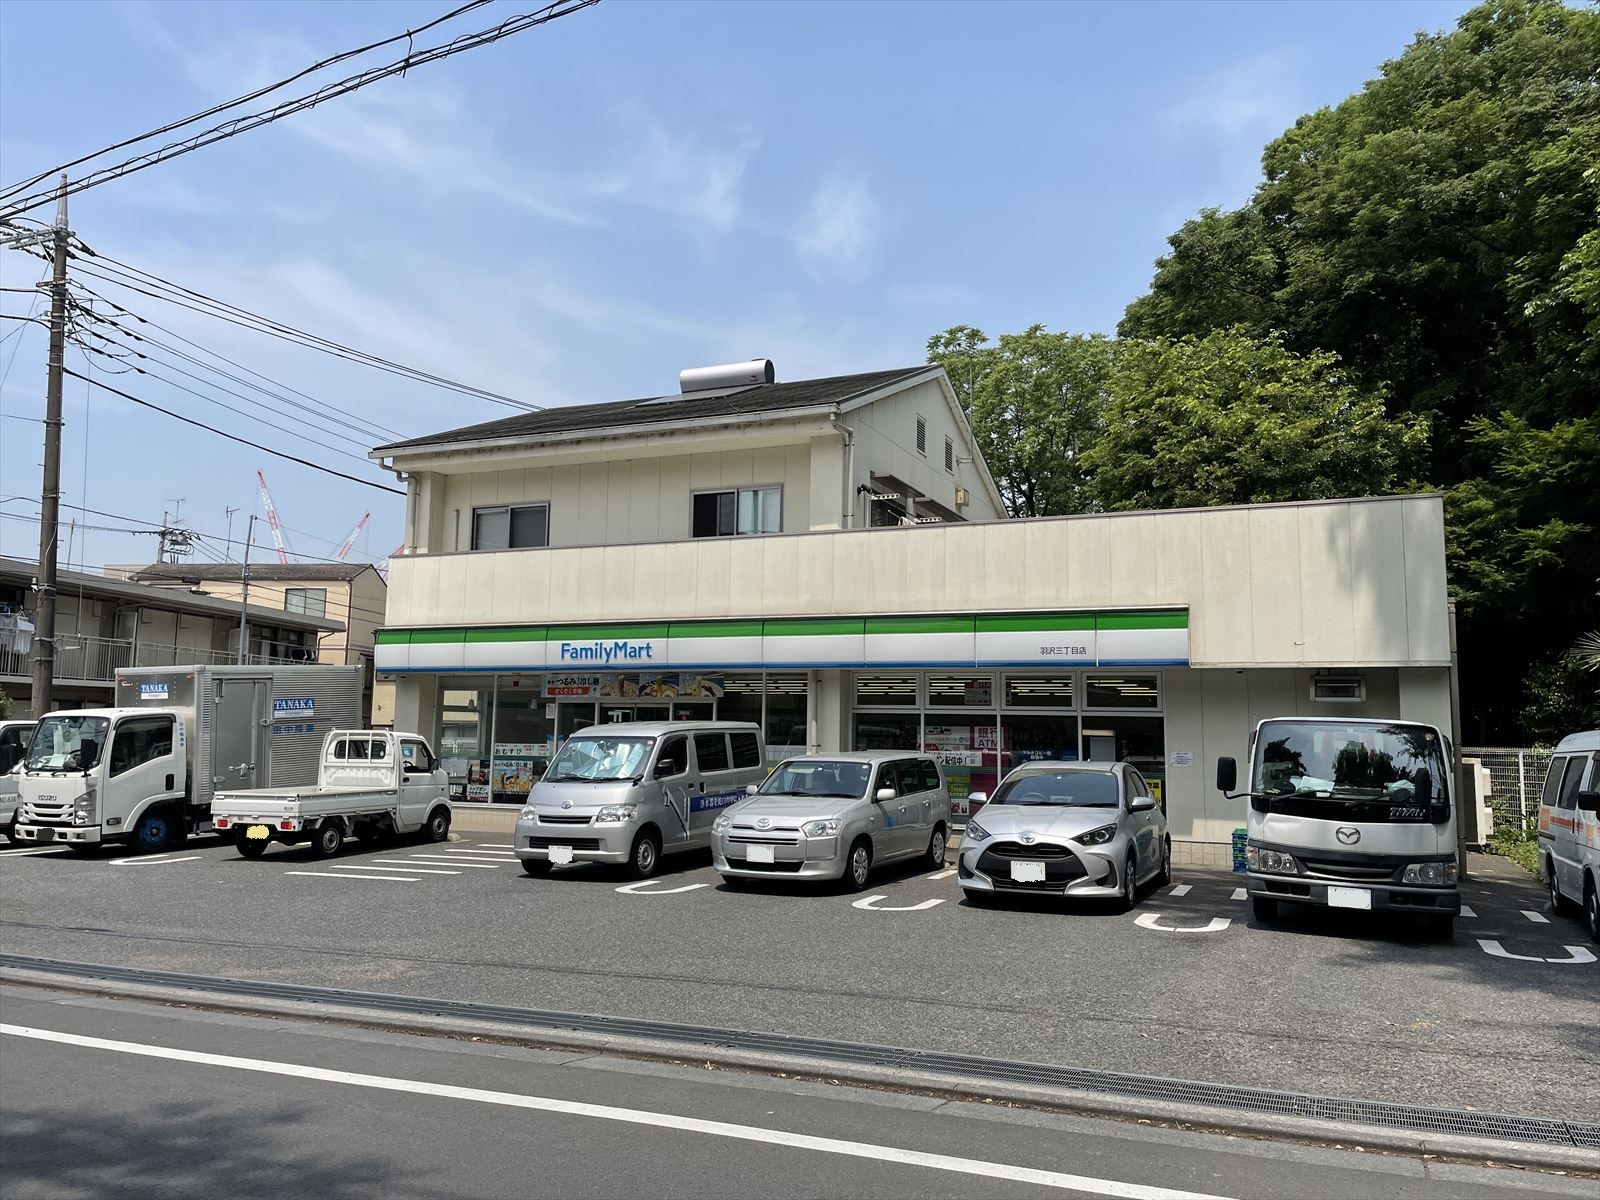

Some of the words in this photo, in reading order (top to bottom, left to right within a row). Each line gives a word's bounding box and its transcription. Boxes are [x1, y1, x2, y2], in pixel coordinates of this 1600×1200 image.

[561, 641, 652, 663] FamilyMart
[1040, 646, 1087, 655] 羽沢三丁目店
[141, 684, 168, 692] TANAKA
[274, 699, 313, 709] TANAKA
[38, 794, 57, 802] ISUZU
